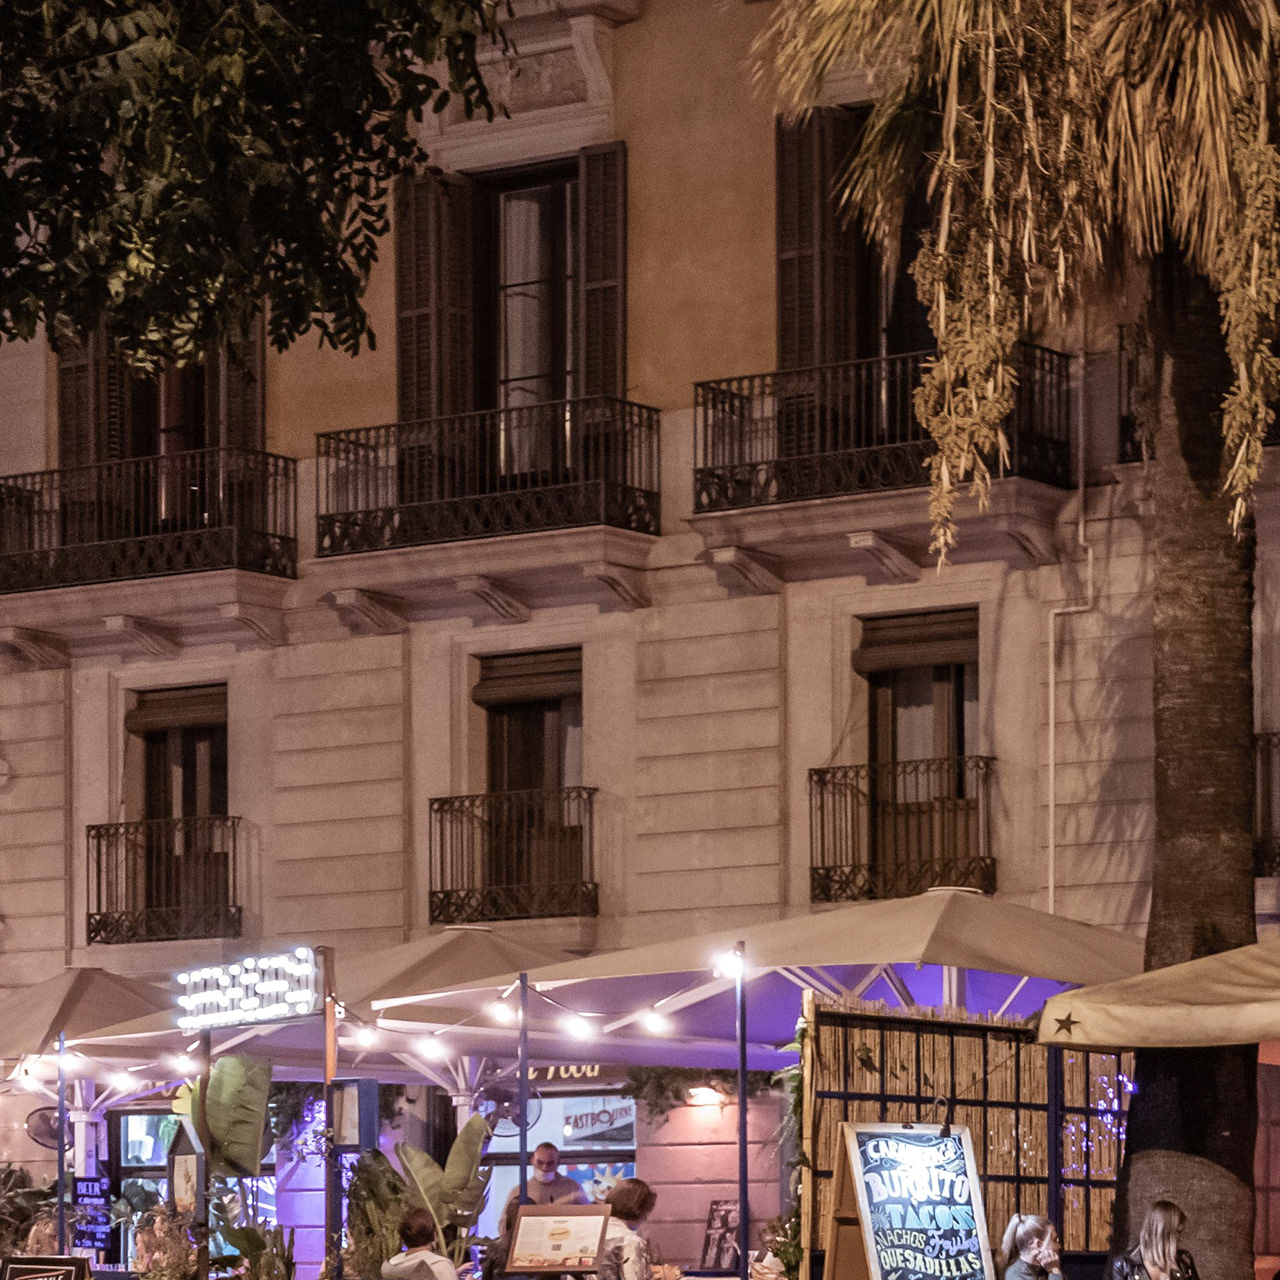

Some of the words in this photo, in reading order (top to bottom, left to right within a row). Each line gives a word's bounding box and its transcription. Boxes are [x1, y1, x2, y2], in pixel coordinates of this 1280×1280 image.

[77, 1182, 101, 1195] BEER
[864, 1164, 970, 1204] BURRITO
[885, 1204, 977, 1230] TACOS
[876, 1230, 926, 1251] NACHOS
[880, 1248, 982, 1277] QUESADILLAS
